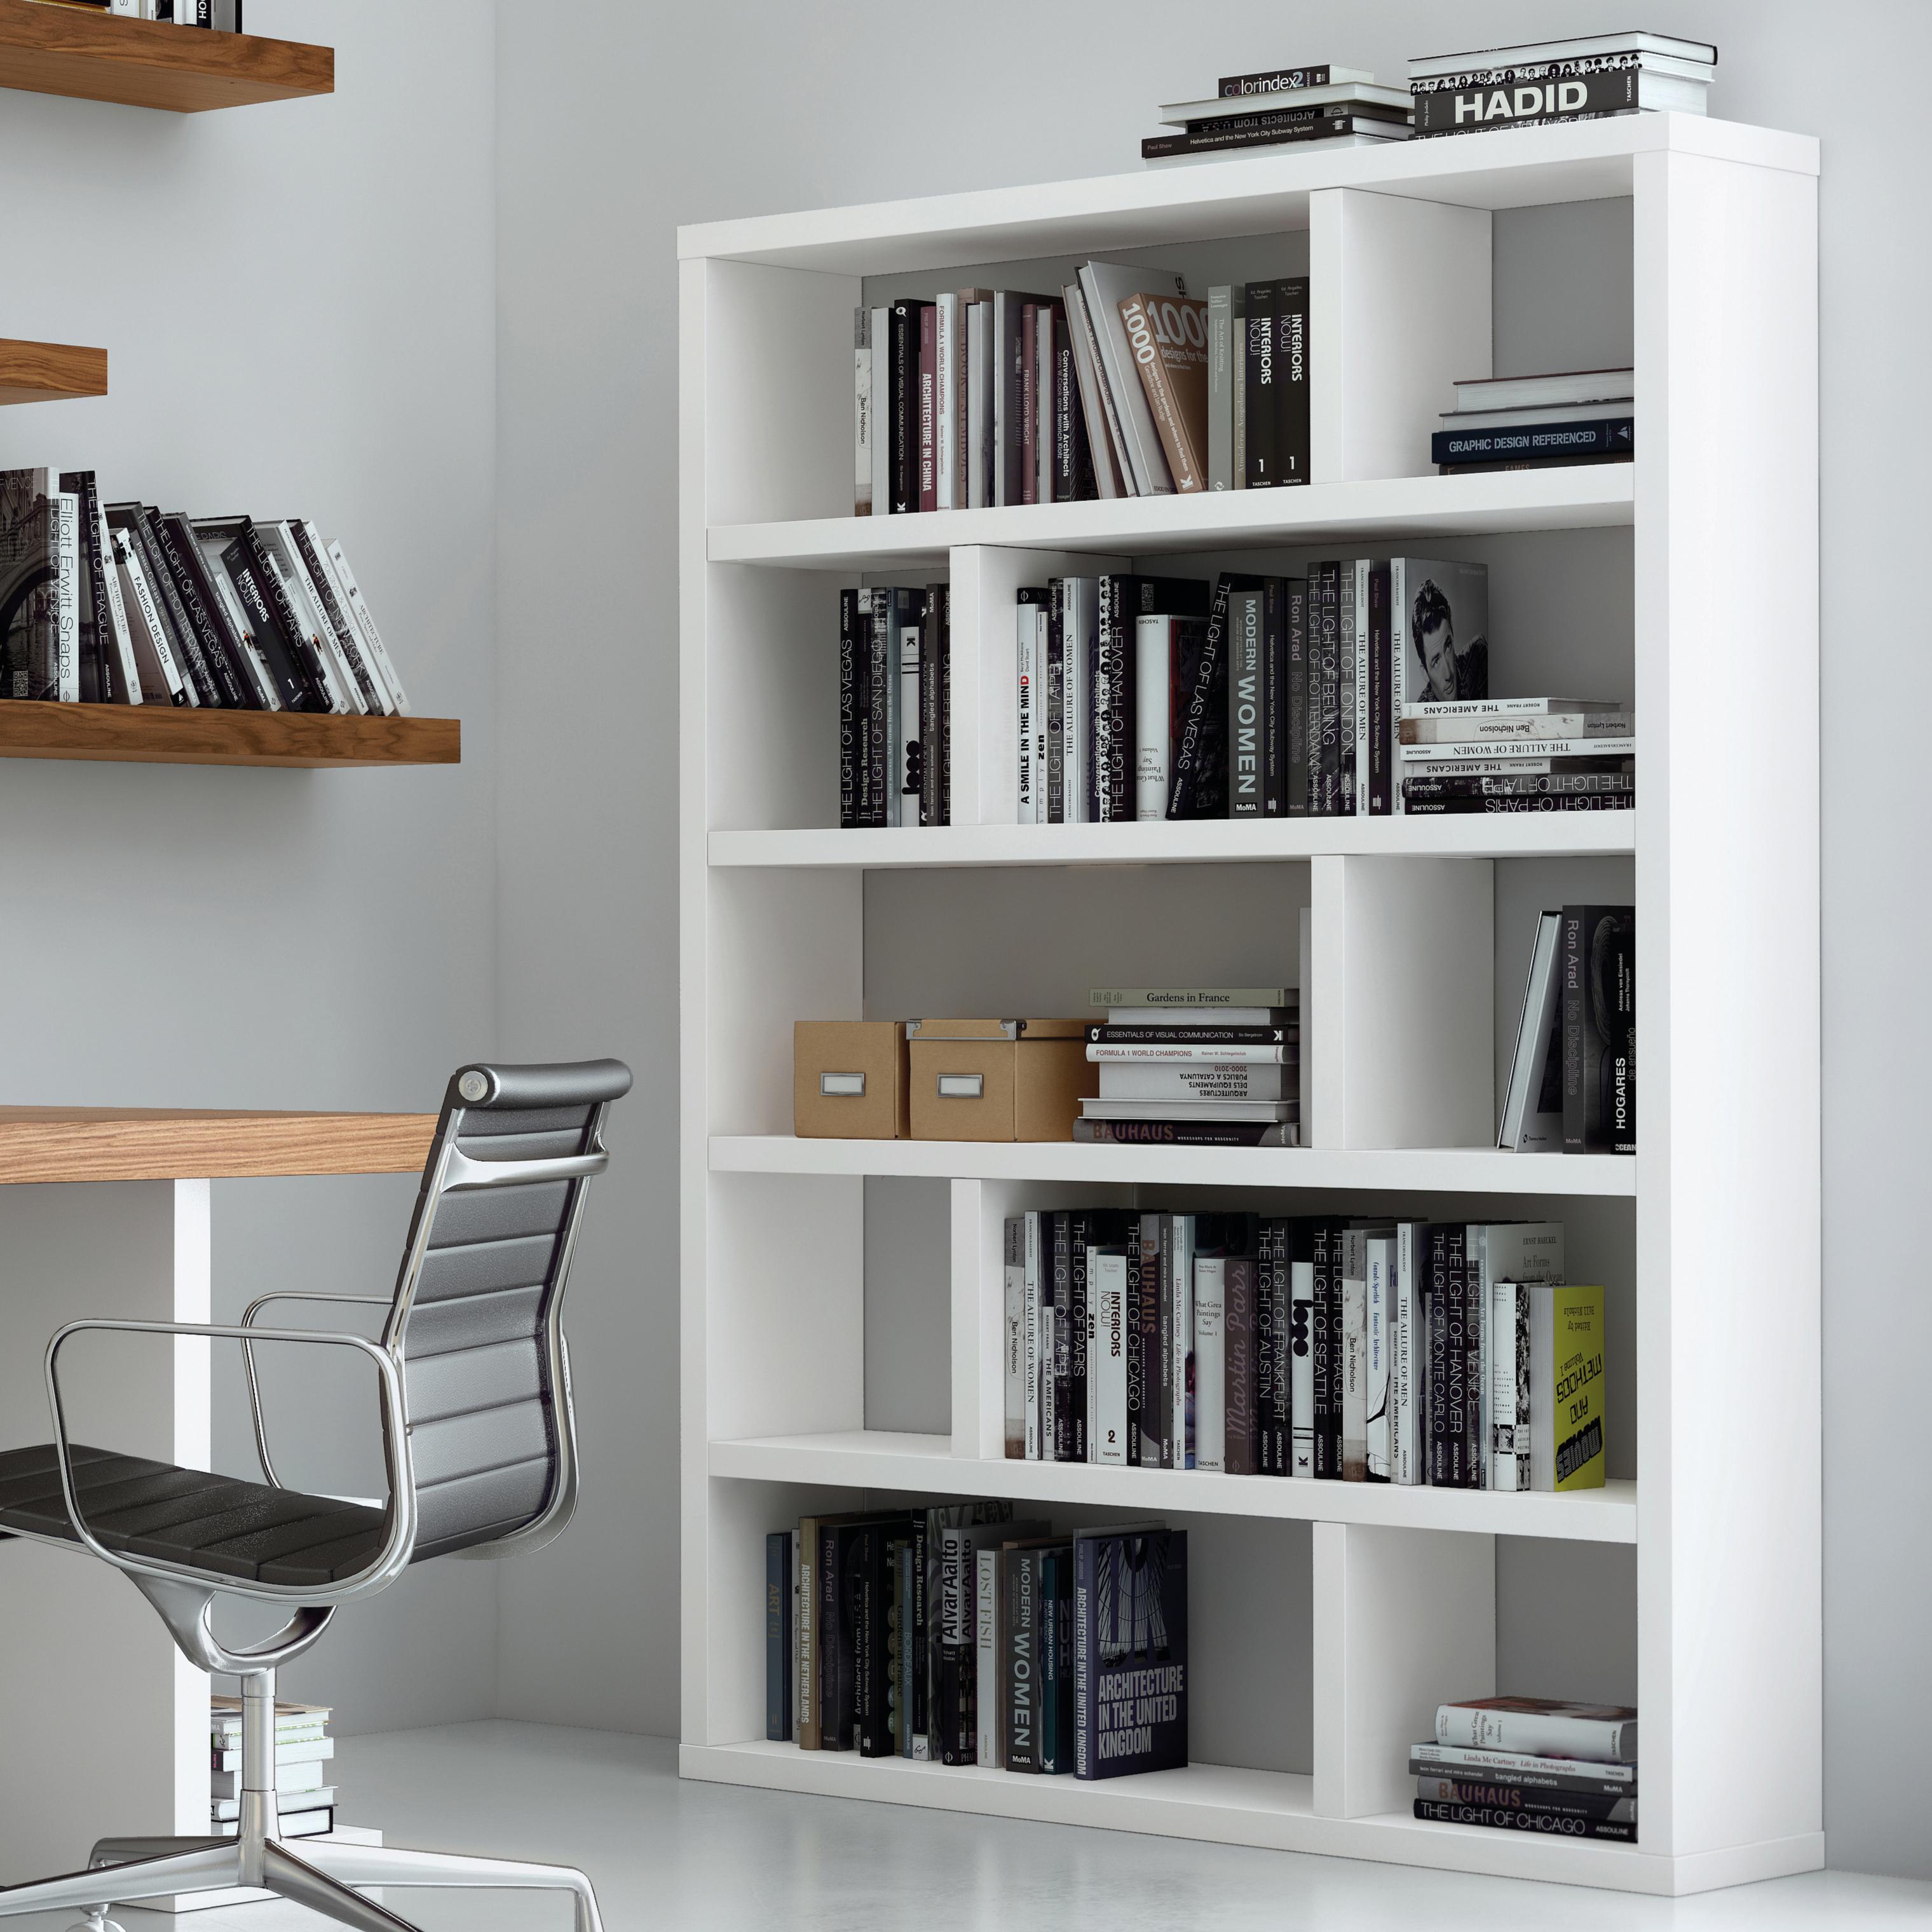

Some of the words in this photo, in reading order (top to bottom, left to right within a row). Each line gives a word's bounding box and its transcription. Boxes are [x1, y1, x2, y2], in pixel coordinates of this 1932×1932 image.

[1224, 71, 1303, 97] colorindex2
[1454, 81, 1587, 124] HADID
[1190, 136, 1213, 145] Helvetica
[1271, 127, 1293, 136] Subway
[1293, 125, 1314, 133] System
[1122, 303, 1155, 364] 1000
[1249, 318, 1260, 355] NOW!
[1281, 315, 1291, 352] NOW!
[1291, 314, 1302, 381] INTERIORS
[1161, 347, 1186, 362] designs
[1187, 348, 1195, 362] for
[1261, 318, 1270, 384] INTERIORS
[923, 374, 932, 446] ARCHITECTURE
[923, 448, 932, 458] IN
[1449, 438, 1492, 452] GRAPHIC
[1494, 435, 1530, 450] DESIGN
[1532, 430, 1596, 446] REFERENCED
[923, 461, 932, 492] CHINA
[1258, 459, 1264, 472] 1
[1289, 456, 1295, 469] 1
[87, 481, 99, 508] THE
[60, 498, 74, 548] Elliott
[89, 512, 102, 554] LIGHT
[60, 556, 74, 608] Erwitt
[94, 557, 104, 580] OF
[236, 574, 254, 606] NOW!
[242, 568, 270, 622] INTERIORS
[1213, 583, 1232, 614] THE
[96, 582, 109, 645] PRAGUE
[135, 576, 154, 623] FASHION
[151, 623, 170, 665] DESIGN
[1291, 595, 1302, 623] Ron
[60, 616, 74, 678] Snaps
[1204, 615, 1224, 660] LIGHT
[1246, 599, 1257, 670] MODERN
[1291, 629, 1302, 661] Arad
[1112, 627, 1123, 705] HANOVER
[1199, 661, 1213, 684] OF
[287, 678, 295, 689] 1
[1021, 676, 1029, 709] MIND
[1190, 685, 1208, 714] LAS
[1021, 712, 1029, 735] THE
[1112, 708, 1123, 732] OF
[1359, 700, 1366, 714] OF
[1424, 705, 1478, 714] AMERICANS
[861, 718, 869, 766] Research
[1021, 738, 1029, 751] IN
[1178, 718, 1199, 770] VEGAS
[1238, 675, 1256, 793] WOMEN
[1480, 725, 1514, 734] Nicholson
[1021, 756, 1029, 792] SMILE
[1112, 735, 1123, 782] LIGHT
[861, 770, 869, 806] Design
[1021, 796, 1029, 805] A
[1112, 784, 1123, 816] THE
[1171, 777, 1183, 813] ASSOULINE
[1556, 796, 1602, 812] LIGHT
[1236, 803, 1257, 812] MoMA
[1485, 798, 1529, 813] PARIS
[1530, 798, 1554, 812] OF
[1568, 920, 1579, 949] Ron
[1568, 954, 1579, 988] Arad
[1146, 992, 1185, 1002] Gardens
[1187, 993, 1196, 1002] in
[1198, 993, 1230, 1002] France
[1568, 1000, 1580, 1020] No
[1567, 1024, 1580, 1095] Discipline
[1616, 1057, 1626, 1129] HOGARES
[1093, 1122, 1174, 1140] BAUHAUS
[1314, 1228, 1326, 1262] THE
[1141, 1240, 1156, 1333] BAUHAUS
[1314, 1265, 1326, 1313] LIGHT
[1100, 1290, 1111, 1326] NOW!
[1111, 1291, 1121, 1357] INTERIORS
[1563, 1307, 1584, 1316] Nichols
[1314, 1316, 1326, 1339] OF
[1567, 1321, 1575, 1332] by
[1575, 1322, 1591, 1331] Edited
[1314, 1342, 1326, 1414] SEATTLE
[1565, 1351, 1584, 1372] Volume
[1557, 1353, 1602, 1404] METHODS
[1570, 1395, 1588, 1425] AND
[1108, 1429, 1116, 1443] 2
[979, 1557, 991, 1604] LOST
[1021, 1558, 1031, 1627] MODERN
[801, 1564, 810, 1631] ARCHITECTURE
[801, 1631, 810, 1641] IN
[979, 1609, 991, 1650] FISH
[1077, 1588, 1087, 1661] ARCHITECTURE
[801, 1642, 810, 1659] THE
[904, 1631, 913, 1685] BORDEAUX
[1077, 1661, 1087, 1670] IN
[801, 1660, 810, 1723] NETHERLANDS
[1014, 1632, 1031, 1746] WOMEN
[1077, 1671, 1087, 1691] THE
[1098, 1665, 1183, 1703] ARCHITECTURE
[1077, 1692, 1087, 1727] UNITED
[1098, 1703, 1110, 1731] IN
[1111, 1699, 1134, 1730] THE
[1136, 1694, 1177, 1725] UNITED
[1077, 1729, 1087, 1775] KINGDOM
[1098, 1725, 1152, 1760] KINGDOM
[1012, 1755, 1031, 1764] MoMA
[1438, 1781, 1521, 1807] BAUHAUS
[1420, 1802, 1449, 1820] THE
[1451, 1806, 1492, 1825] LIGHT
[1493, 1810, 1515, 1826] OF
[1516, 1813, 1586, 1835] CHICAGO
[1595, 1825, 1628, 1835] ASSOULINE
